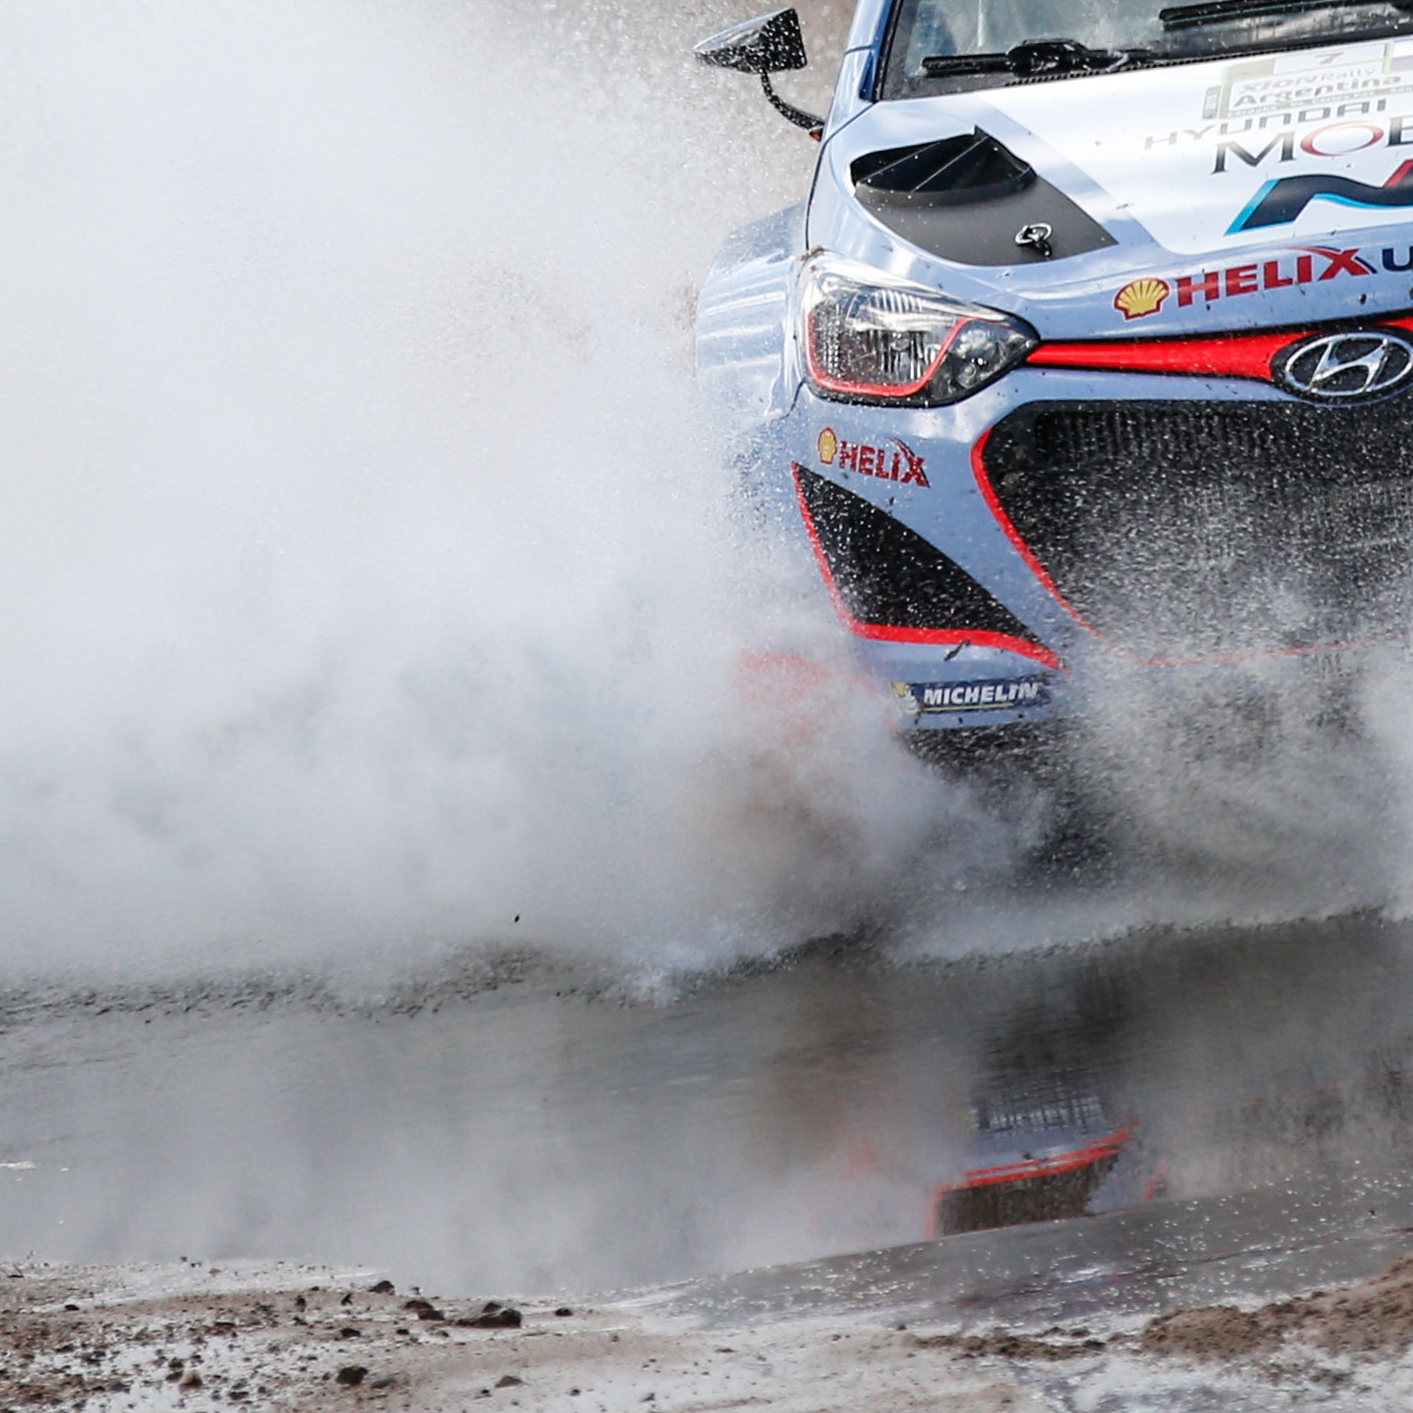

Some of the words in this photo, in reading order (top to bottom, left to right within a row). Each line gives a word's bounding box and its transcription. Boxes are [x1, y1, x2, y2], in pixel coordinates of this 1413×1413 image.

[1314, 51, 1345, 66] 7
[1320, 68, 1376, 83] Rally
[1233, 75, 1401, 109] Argentina
[1144, 98, 1388, 150] HYUNDAI
[1176, 244, 1378, 307] HELIX
[839, 437, 931, 488] HELIX
[923, 682, 1043, 706] MICHELIN
